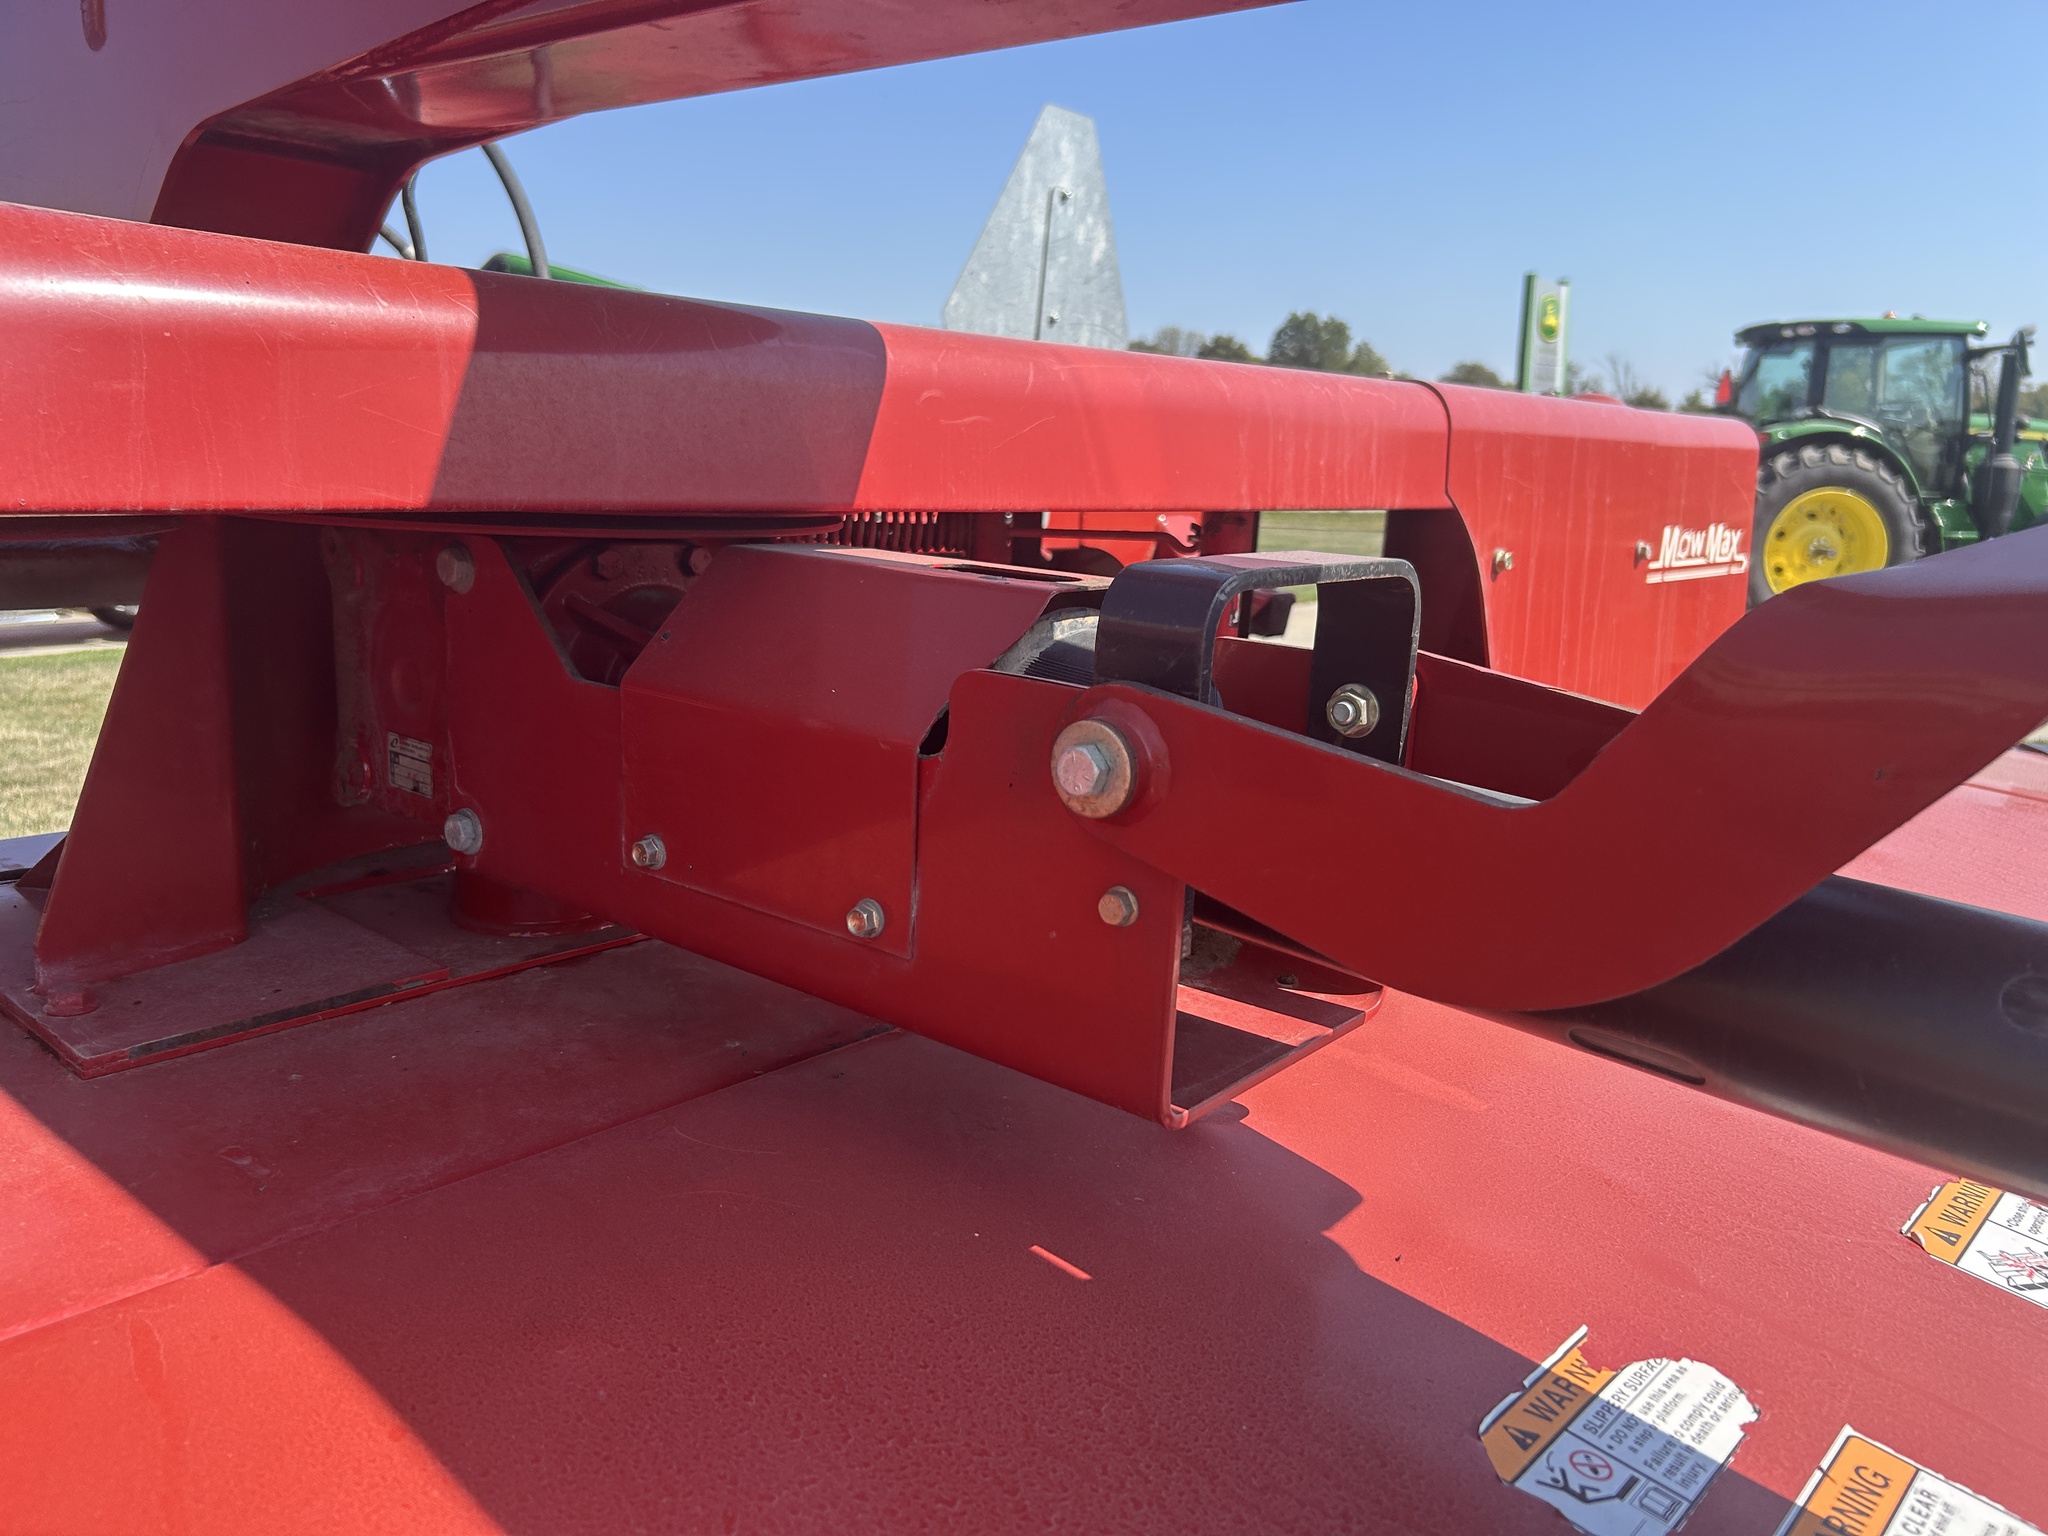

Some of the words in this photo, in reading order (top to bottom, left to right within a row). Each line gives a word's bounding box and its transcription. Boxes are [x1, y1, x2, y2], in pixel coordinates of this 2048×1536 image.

[1702, 1379, 1726, 1405] could
[1582, 1387, 1630, 1435] SLIPPERY
[1610, 1428, 1628, 1445] DO
